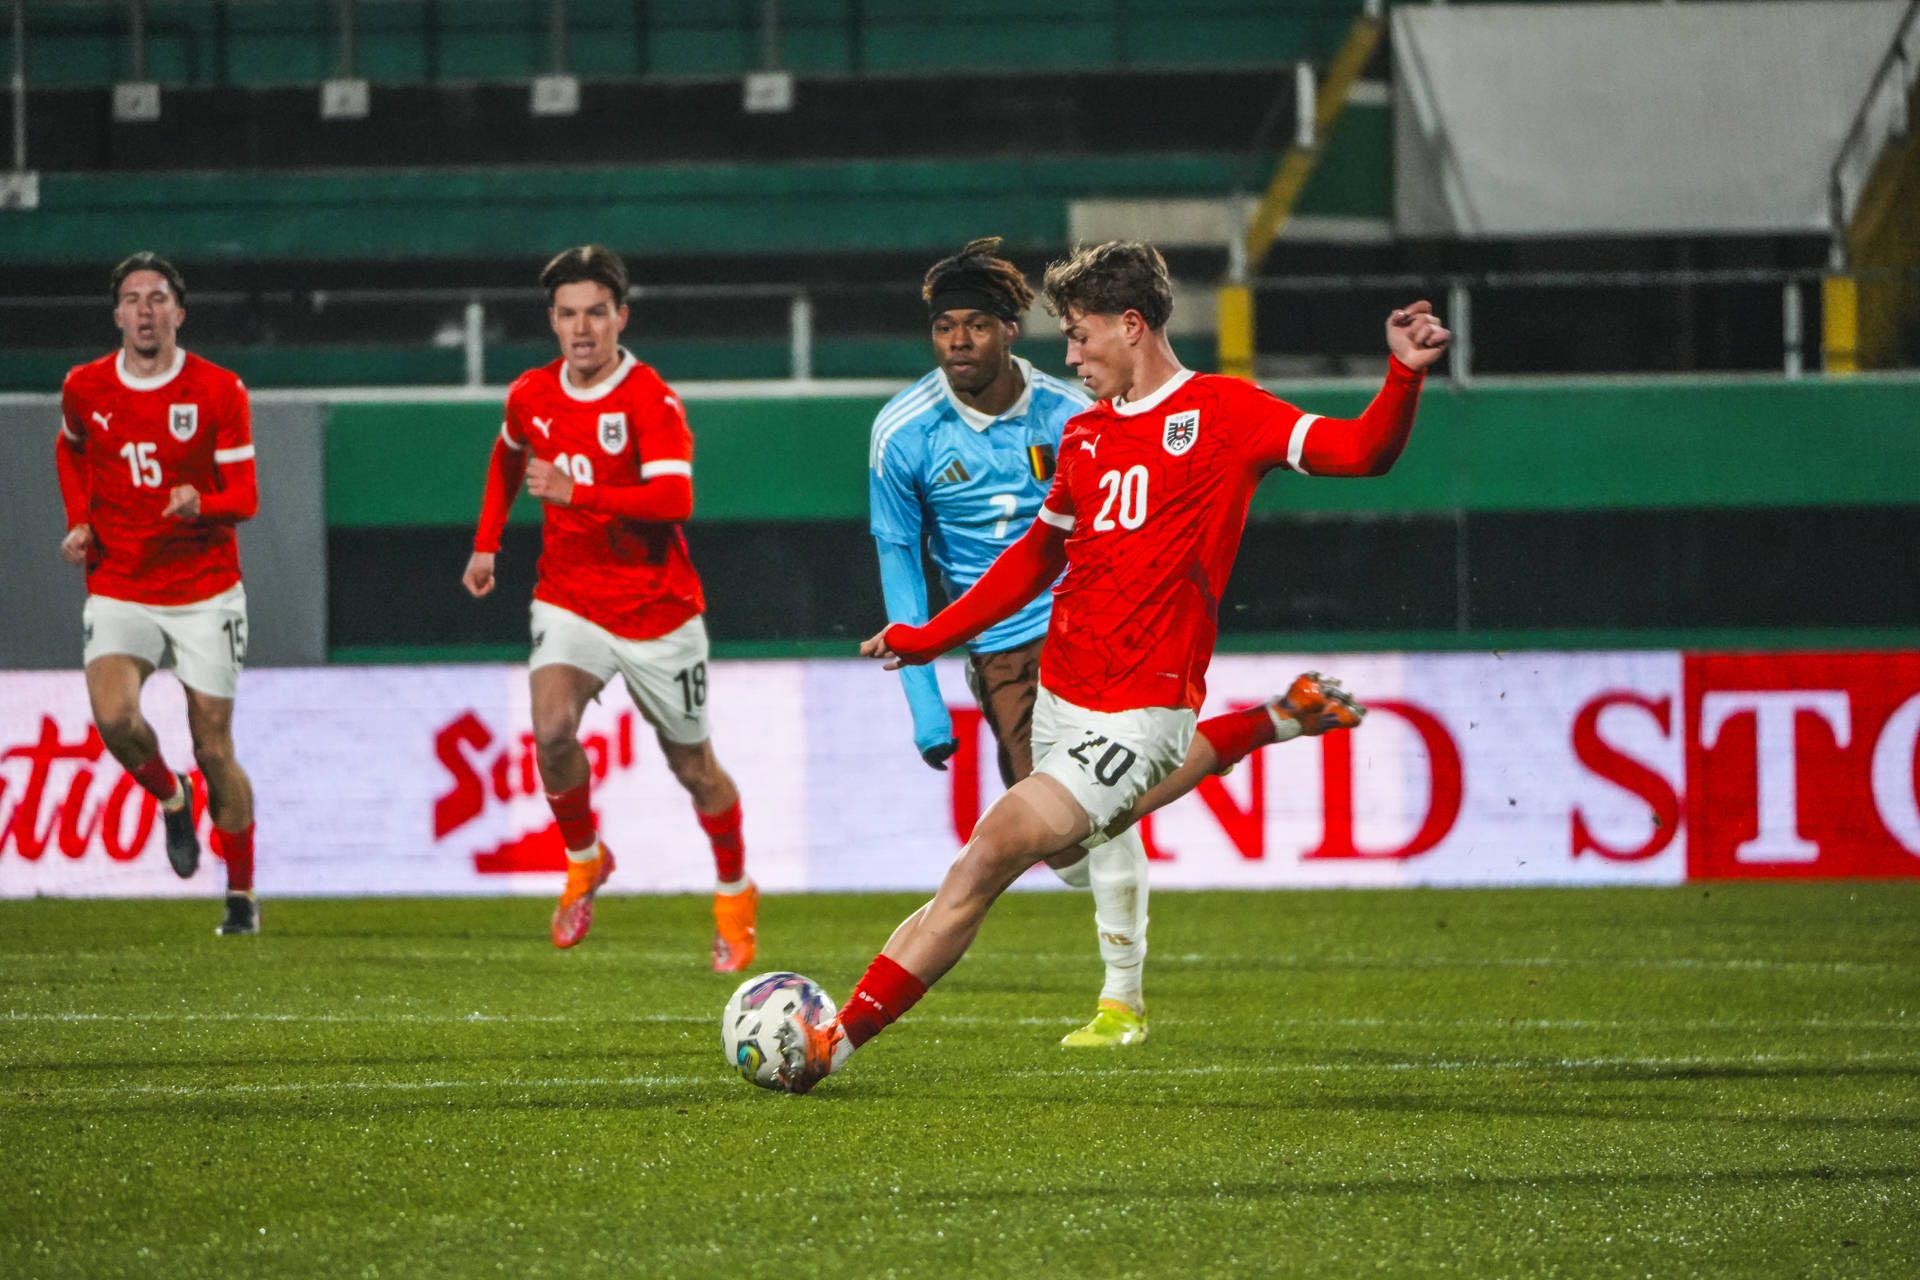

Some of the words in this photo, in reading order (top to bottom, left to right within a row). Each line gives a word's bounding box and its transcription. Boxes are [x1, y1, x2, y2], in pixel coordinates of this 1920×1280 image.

[120, 442, 163, 488] 15
[988, 494, 1017, 539] 7
[1093, 465, 1149, 532] 20
[673, 660, 706, 713] 18
[434, 706, 634, 842] Stigl
[1068, 731, 1137, 787] 20
